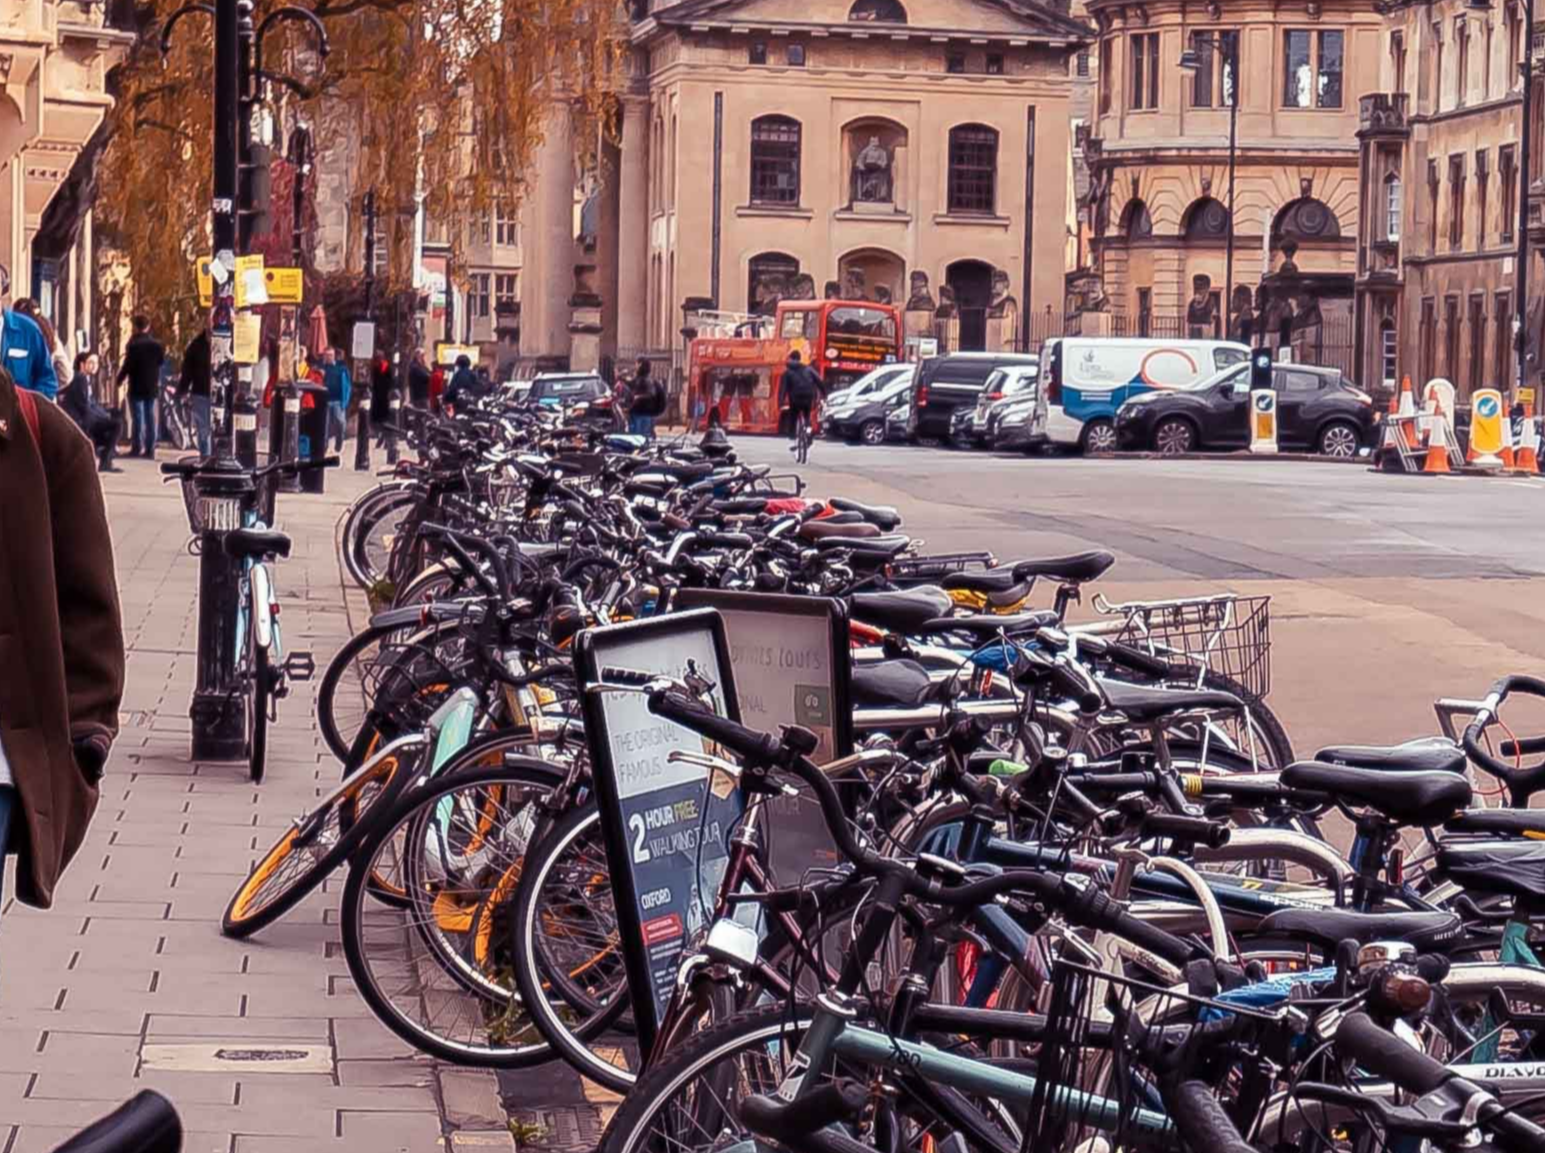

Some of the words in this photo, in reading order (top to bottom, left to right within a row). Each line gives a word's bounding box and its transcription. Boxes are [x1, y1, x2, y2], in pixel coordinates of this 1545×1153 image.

[614, 732, 634, 753] THE
[634, 723, 679, 751] ORIGINAL
[619, 756, 662, 784] FAMOUS
[644, 805, 675, 830] HOUR
[674, 799, 699, 822] FREE
[628, 813, 651, 864] 2
[649, 828, 696, 858] WALKING
[693, 821, 723, 846] TOUR
[640, 887, 672, 910] OXFORD
